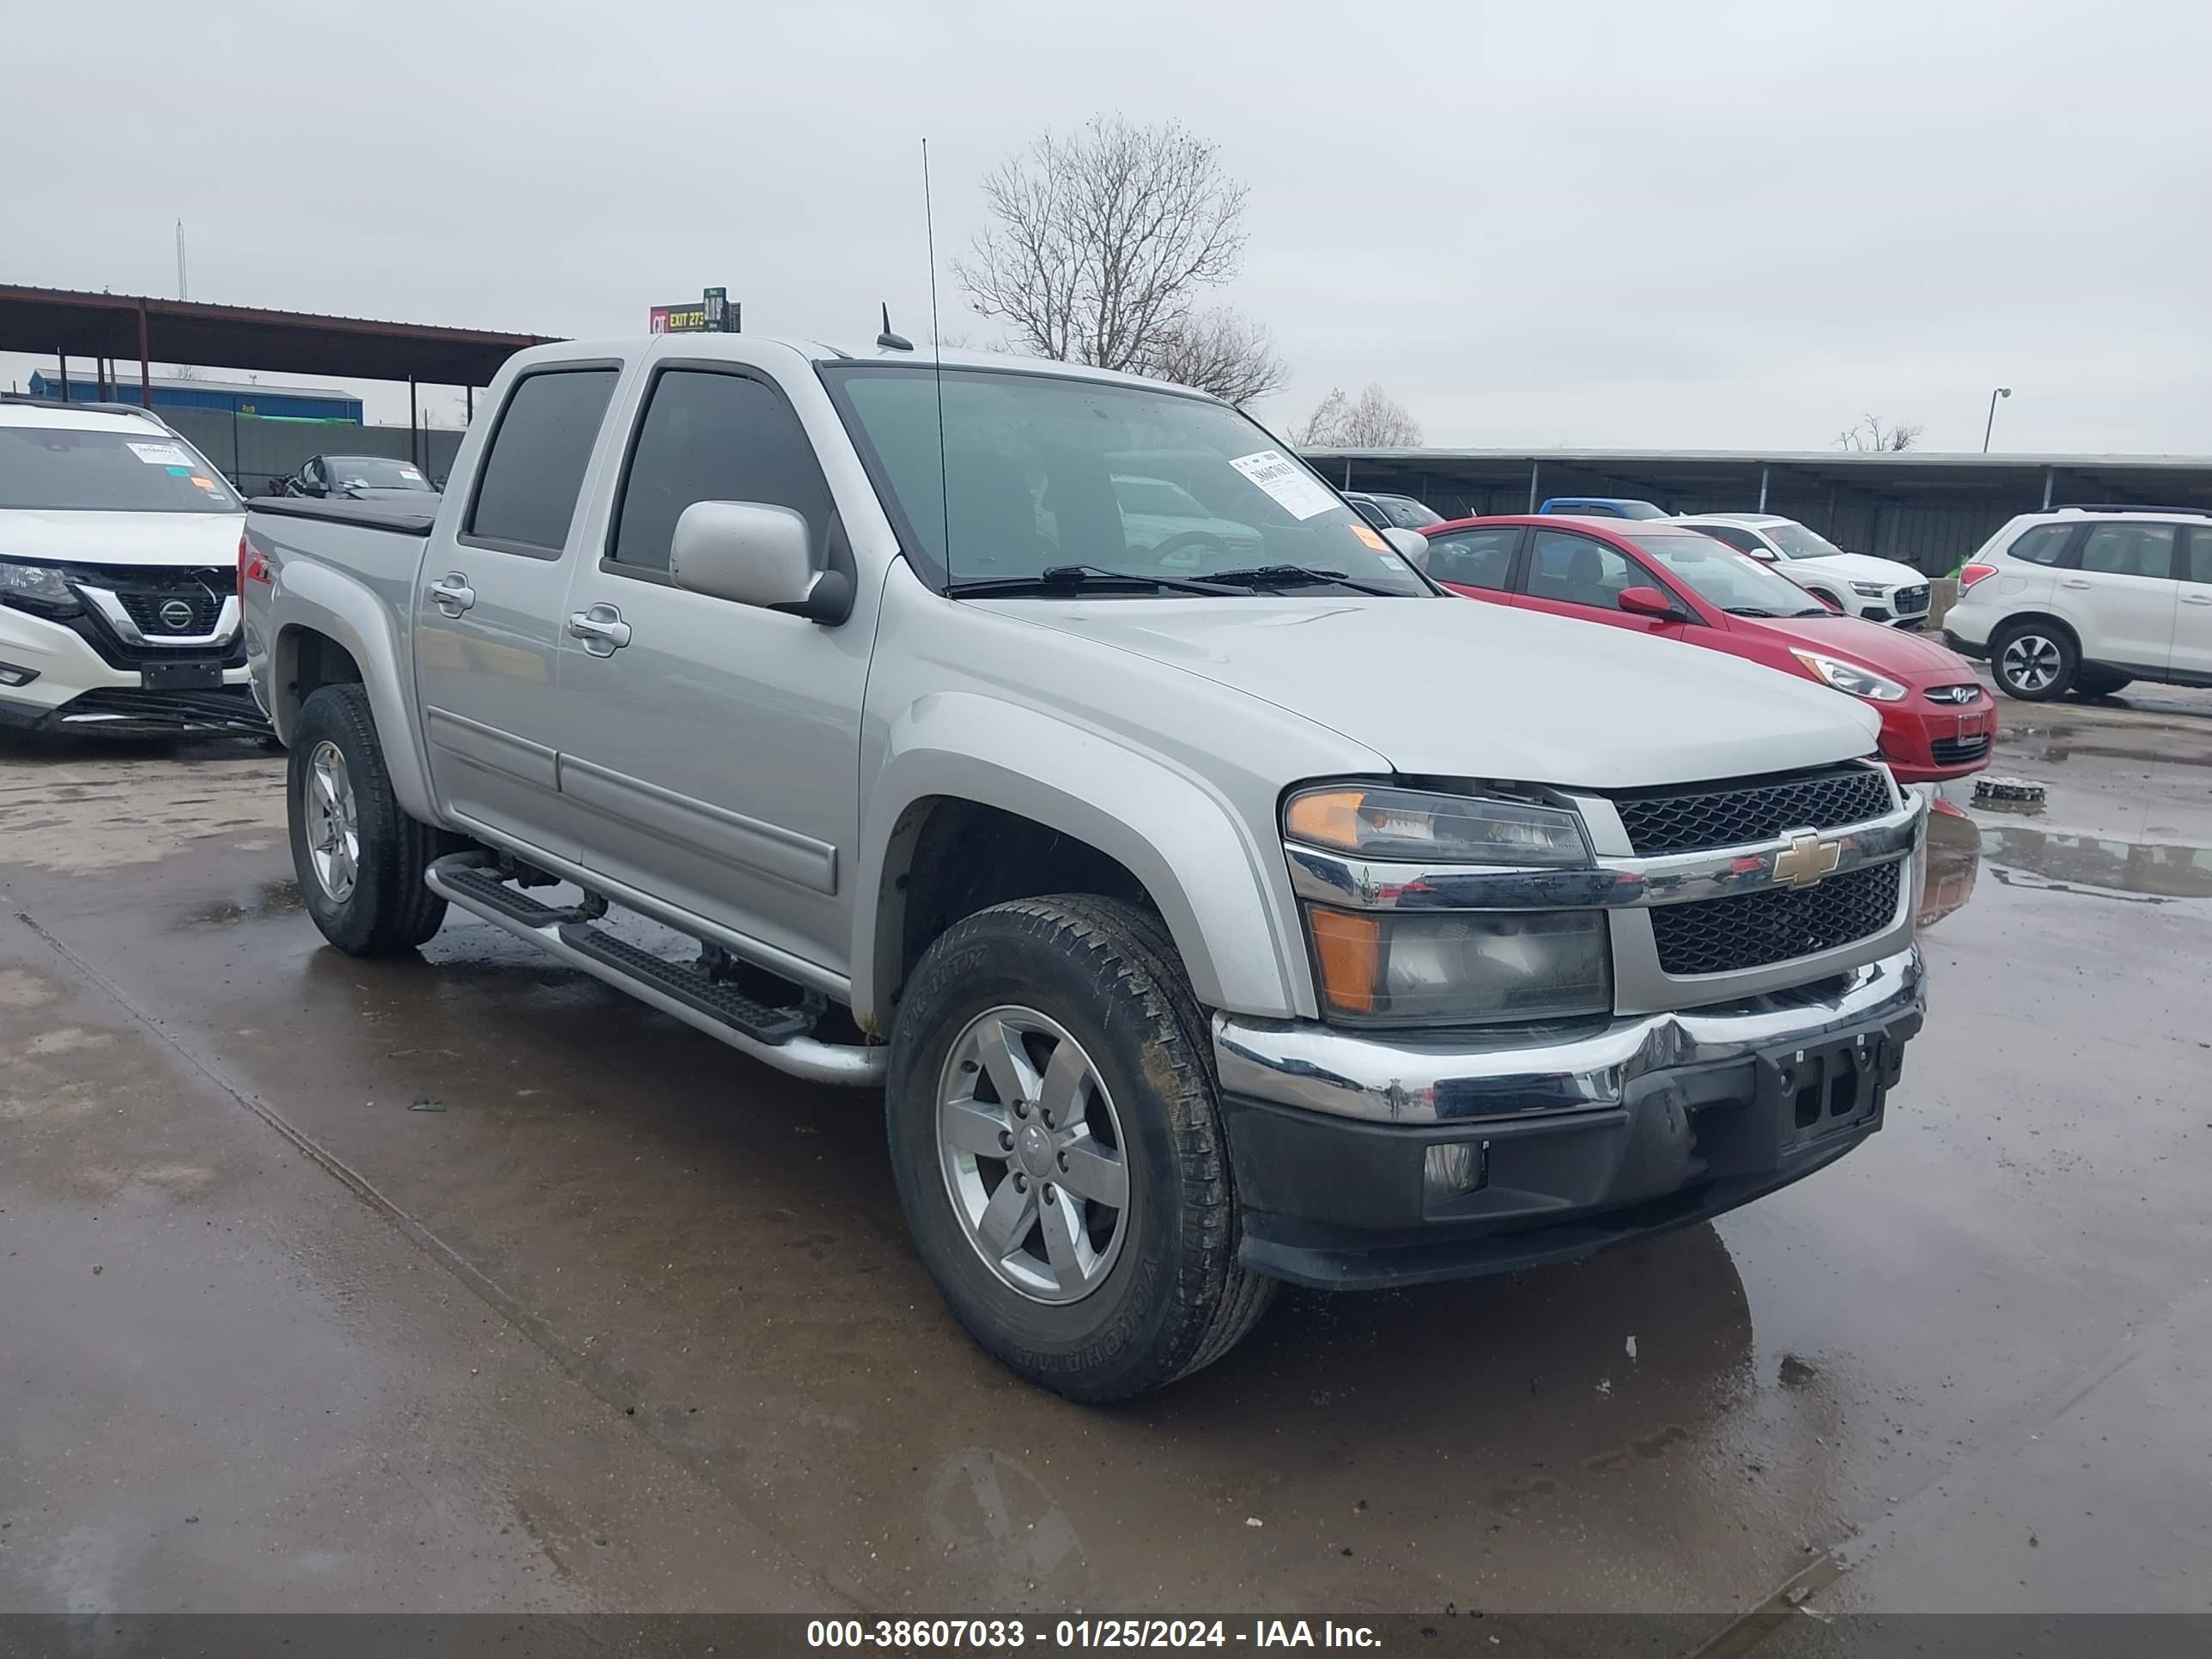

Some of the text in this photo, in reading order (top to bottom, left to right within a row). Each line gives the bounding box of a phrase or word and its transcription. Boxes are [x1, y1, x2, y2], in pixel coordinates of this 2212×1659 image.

[670, 311, 704, 327] EXIT 273
[1250, 462, 1295, 483] 38607033
